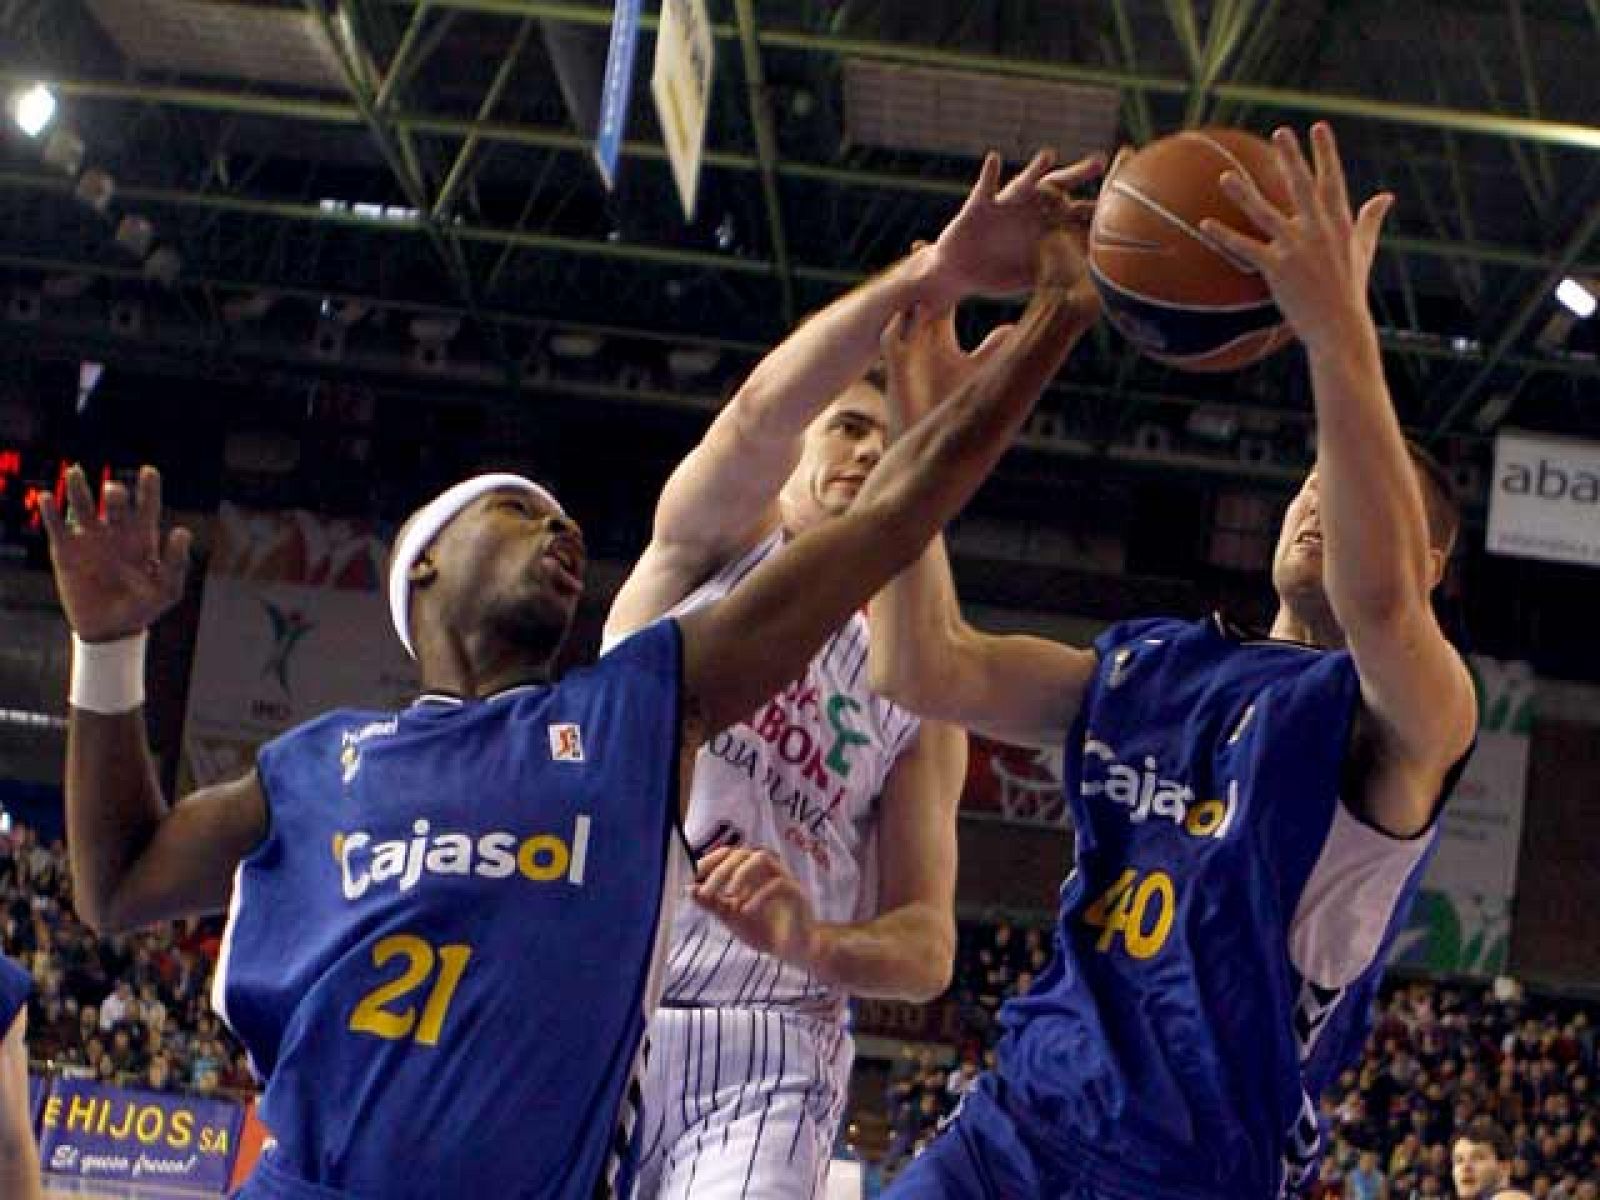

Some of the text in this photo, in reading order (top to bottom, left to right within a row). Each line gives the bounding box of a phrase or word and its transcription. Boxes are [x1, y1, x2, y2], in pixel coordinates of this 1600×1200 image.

[333, 813, 591, 900] Cajasol
[1085, 867, 1175, 960] 40
[348, 934, 473, 1046] 21
[66, 1094, 196, 1149] HIJOS
[199, 1126, 230, 1155] SA
